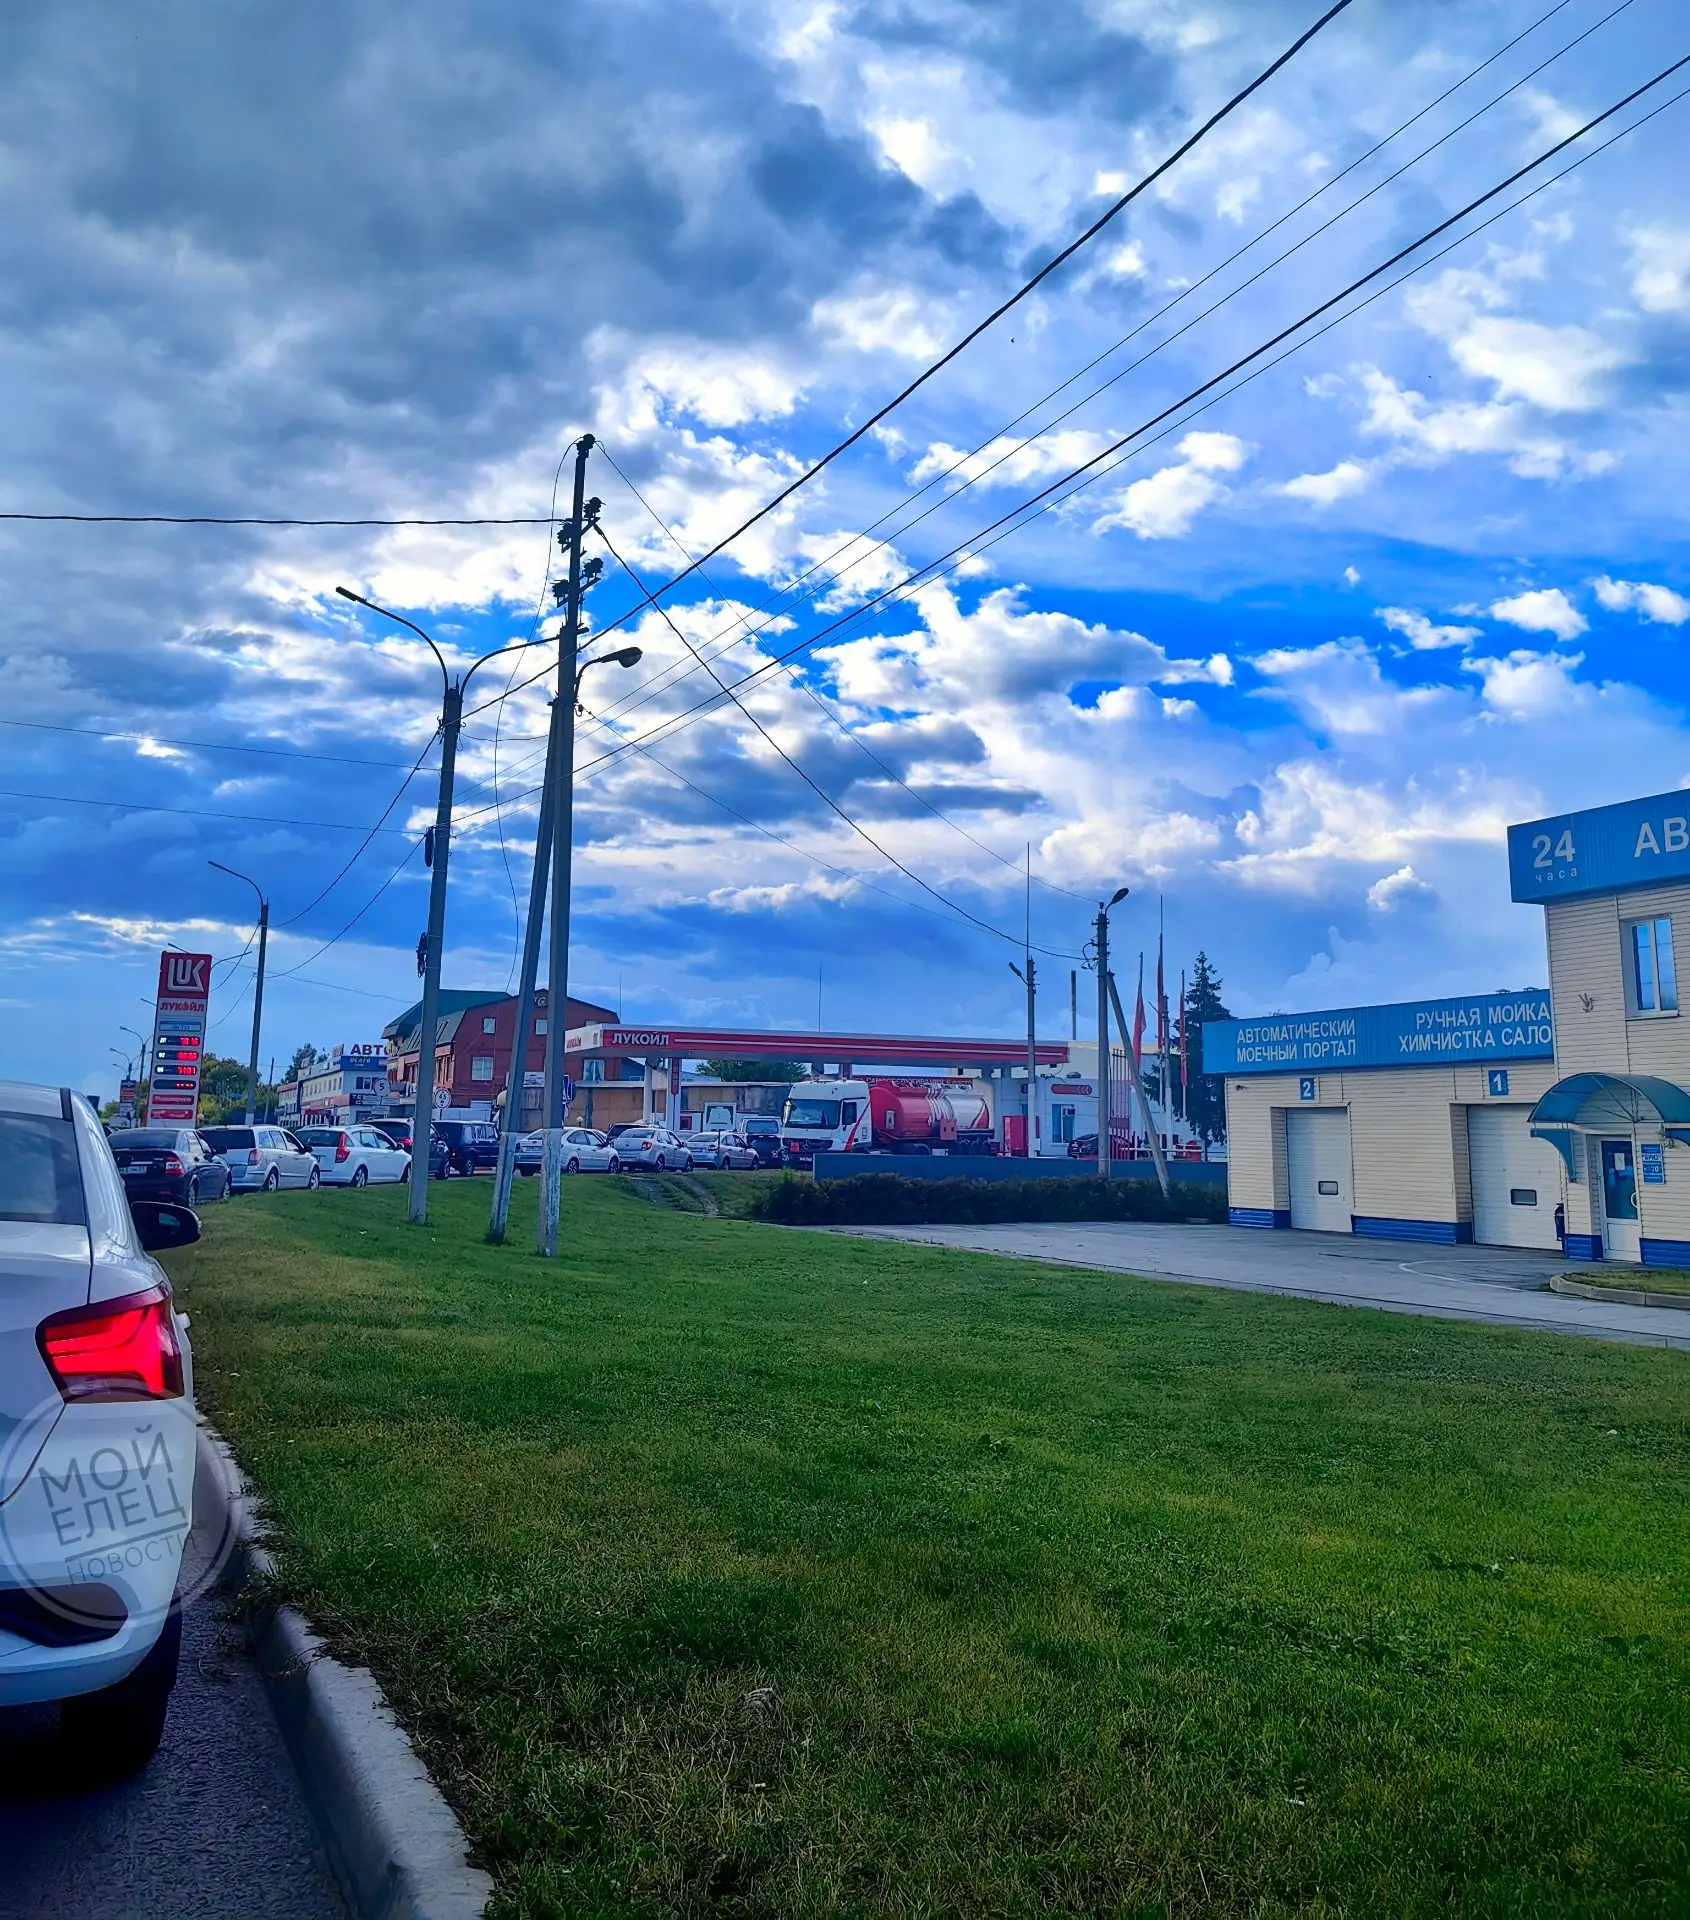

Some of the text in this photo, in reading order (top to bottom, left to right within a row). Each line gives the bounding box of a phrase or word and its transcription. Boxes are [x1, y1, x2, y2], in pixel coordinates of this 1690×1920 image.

[1532, 829, 1576, 868] 24
[1535, 867, 1577, 883] часа
[1416, 1001, 1551, 1030] РУЧНАЯ МОЙКА
[612, 1031, 669, 1046] ЛУКОЙЛ
[1237, 1018, 1355, 1044] АВТОМАТИЧЕСКИЙ
[1399, 1025, 1551, 1052] ХИМЧИСТКА САЛО
[1237, 1039, 1356, 1063] МОЕЧНЫЙ ПОРТАЛ
[379, 1082, 385, 1090] 5
[1302, 1081, 1311, 1097] 2
[1493, 1073, 1502, 1091] 1
